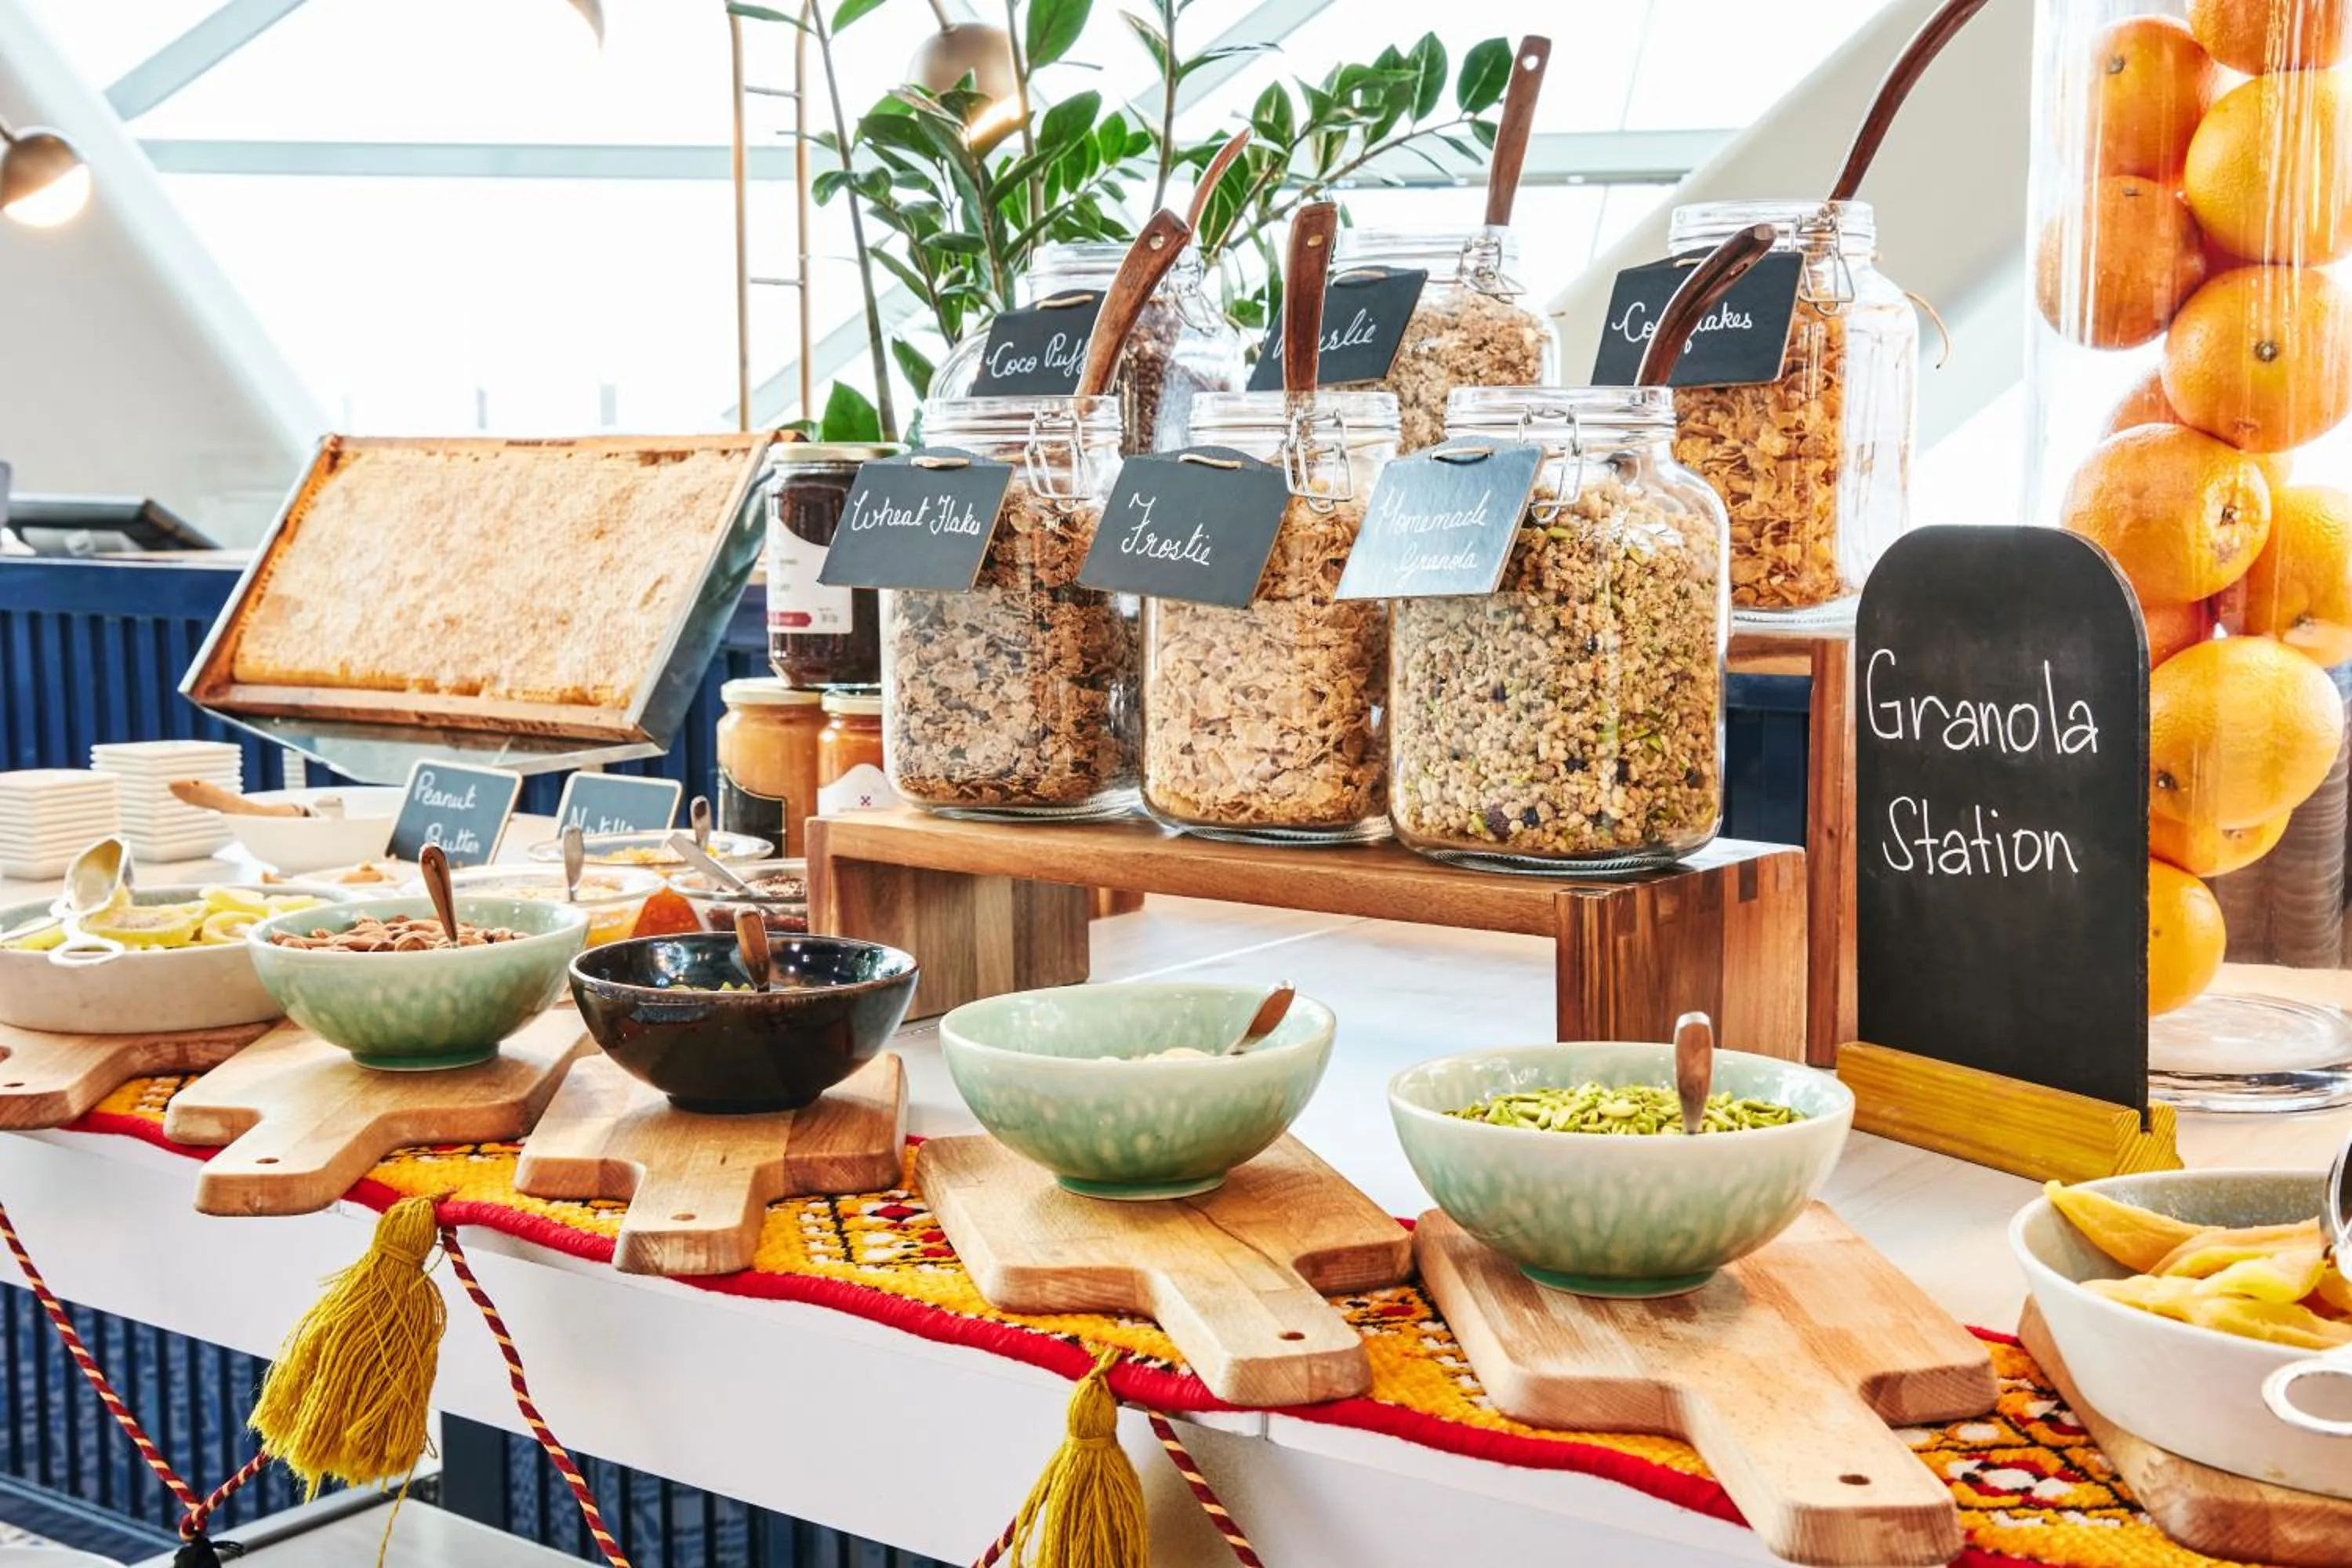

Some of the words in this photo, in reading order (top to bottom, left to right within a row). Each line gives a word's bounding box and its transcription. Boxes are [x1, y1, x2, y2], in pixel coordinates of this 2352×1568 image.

[1272, 308, 1376, 360] slie
[1612, 301, 1751, 354] Coakes
[985, 341, 1037, 378] Coco
[851, 489, 931, 531] Wheat
[1121, 492, 1211, 565] Frostie
[1374, 486, 1490, 535] Homemade
[1395, 541, 1478, 586] Granola
[1866, 648, 2100, 754] Granola
[414, 770, 477, 811] Peanut
[424, 822, 481, 855] Butter
[1882, 796, 2079, 878] Station
